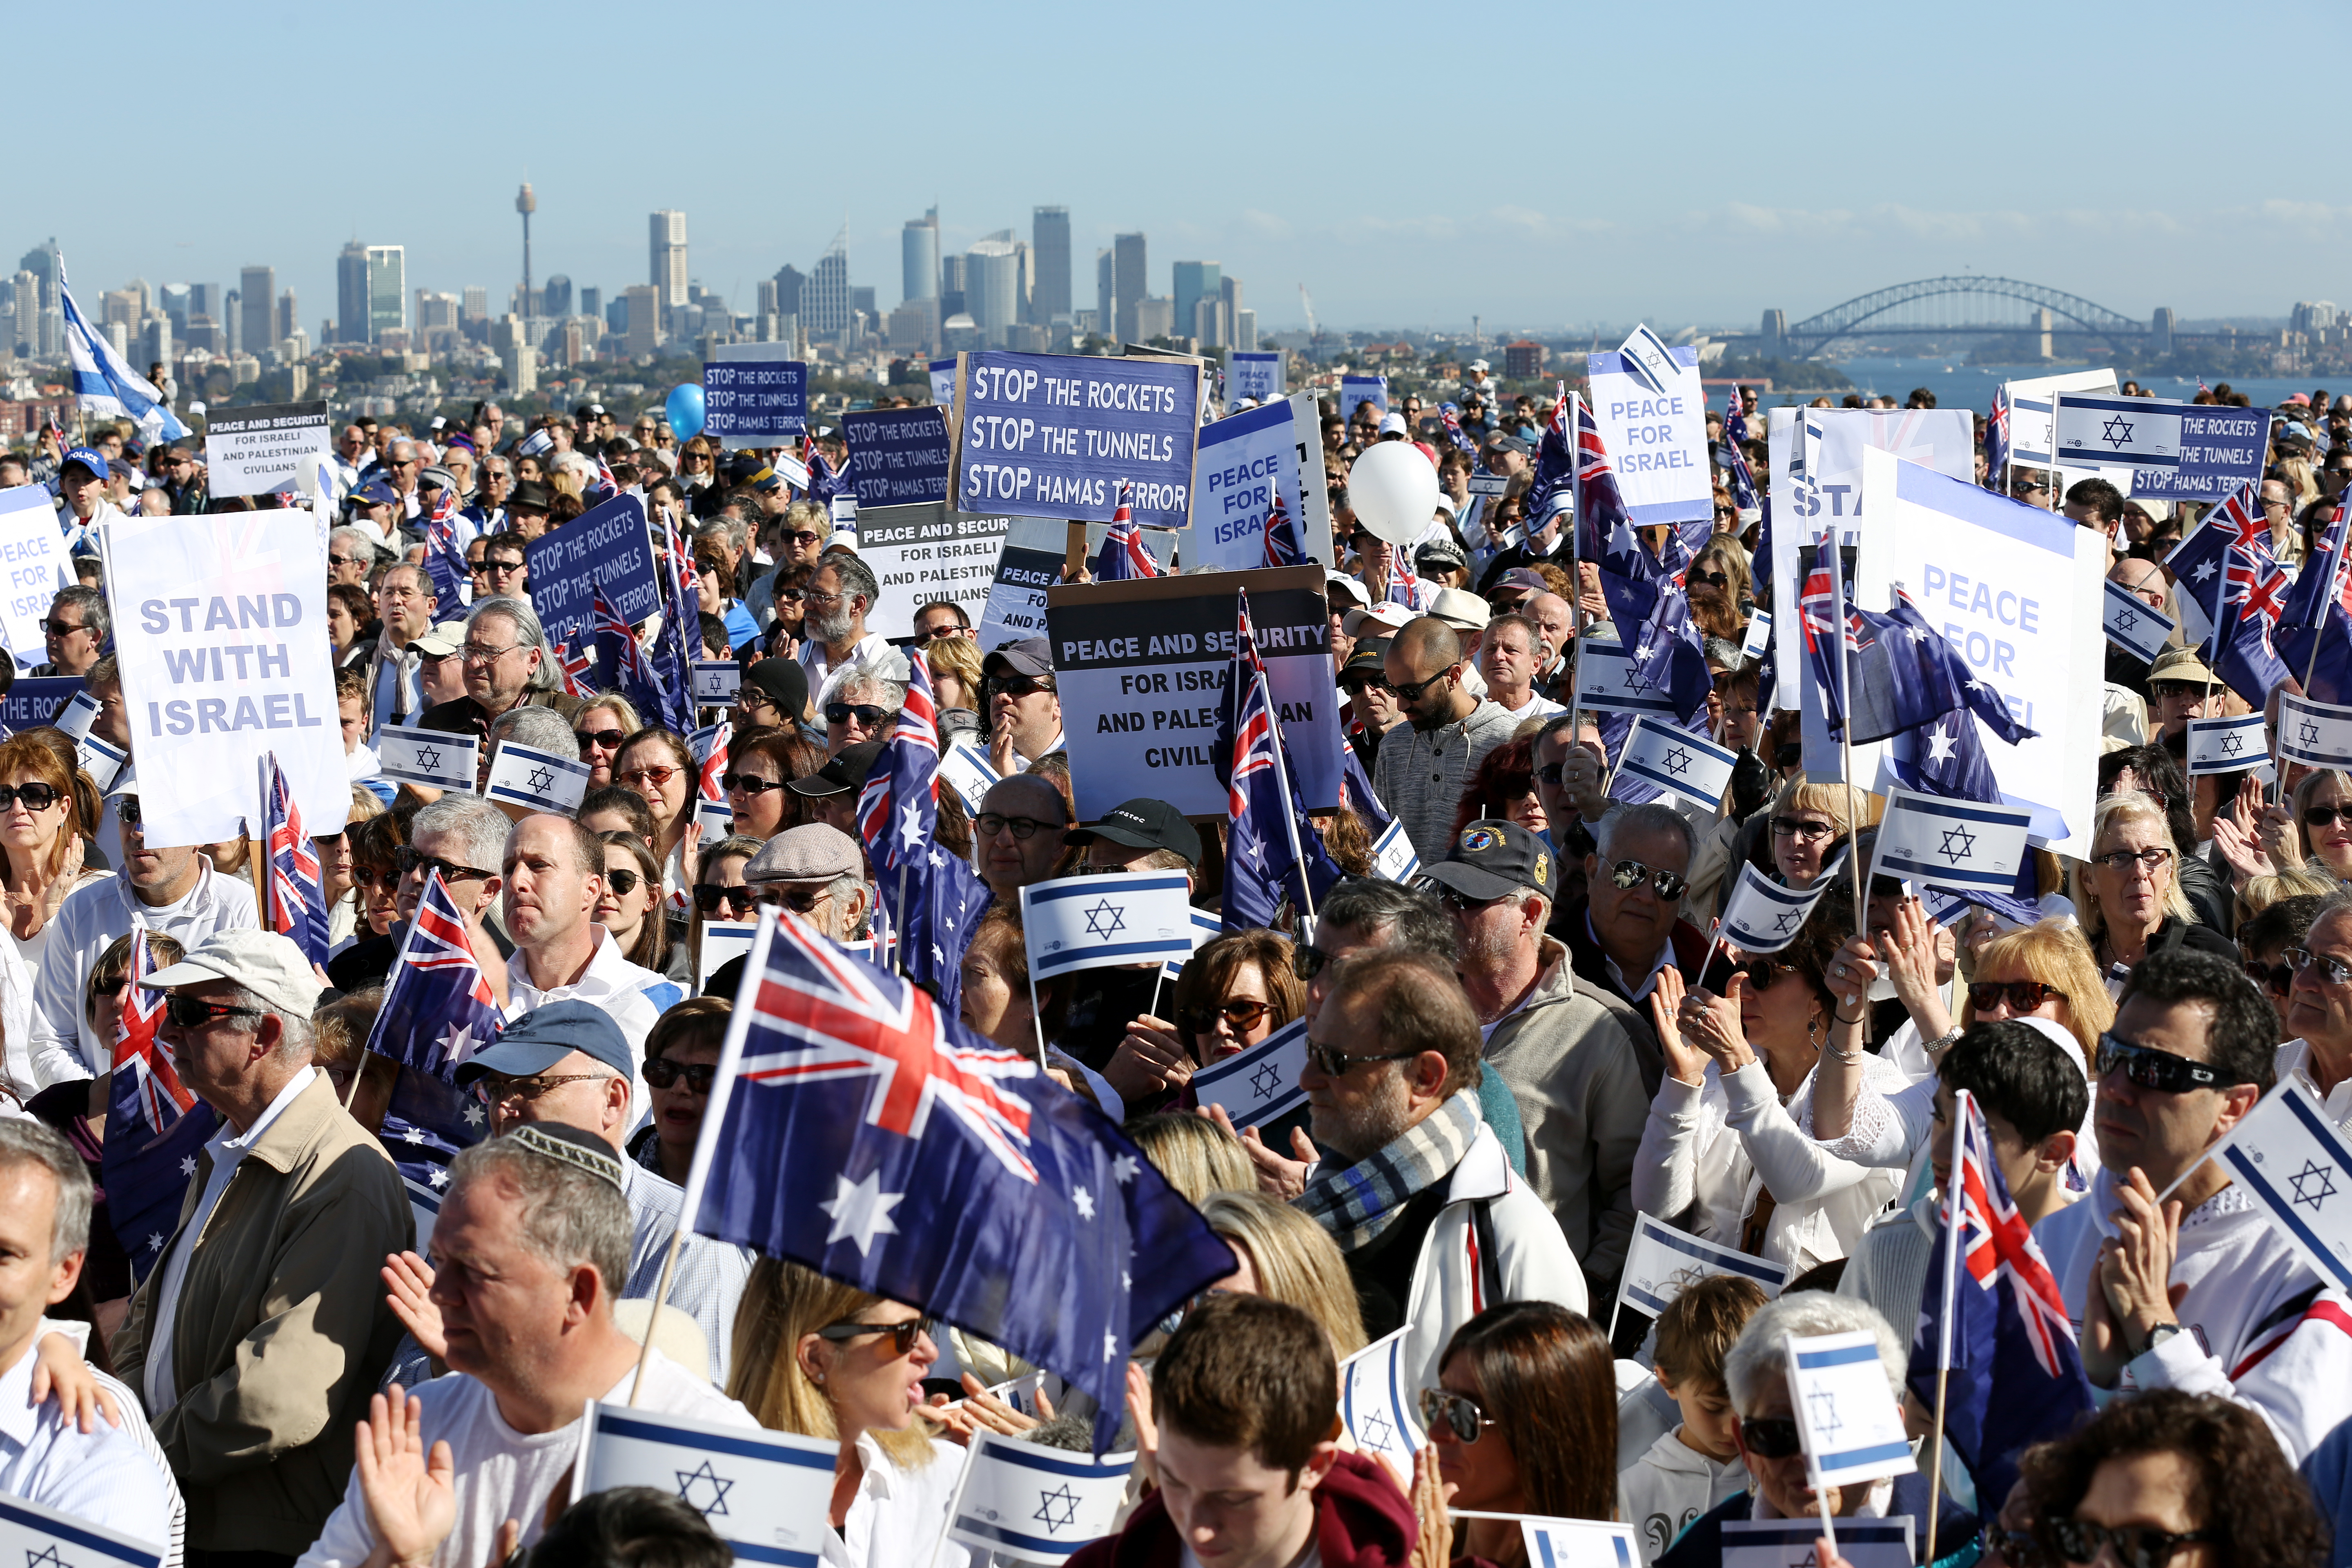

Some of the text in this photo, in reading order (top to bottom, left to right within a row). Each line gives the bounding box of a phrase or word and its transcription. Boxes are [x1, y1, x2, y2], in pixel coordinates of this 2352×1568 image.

[706, 368, 797, 385] STOP THE ROCKETS
[1245, 381, 1265, 389] FOR
[707, 391, 798, 407] STOP THE TUNNELS
[974, 367, 1175, 413] STOP THE ROCKETS
[1611, 397, 1683, 420] PEACE
[210, 414, 327, 433] PEACE AND SECURITY
[707, 413, 736, 429] STOP
[738, 416, 770, 429] HAMAS
[848, 420, 942, 443] STOP THE ROCKETS
[2184, 418, 2257, 437] THE ROCKETS
[235, 432, 301, 445] FOR ISRAELI
[971, 415, 1173, 462] STOP THE TUNNELS
[1627, 425, 1673, 445] FOR
[67, 451, 99, 465] POLICE
[223, 445, 318, 461] AND PALESTINIAN
[853, 448, 949, 471] STOP THE TUNNELS
[1618, 450, 1694, 473] ISRAEL
[2180, 446, 2254, 464] THE TUNNELS
[243, 463, 297, 474] CIVILIANS
[1209, 454, 1278, 492] PEACE
[859, 478, 889, 499] STOP
[891, 479, 924, 497] HAMAS
[967, 464, 1031, 500] STOP
[1037, 475, 1105, 506] HAMAS
[2136, 470, 2173, 490] STOP
[2174, 475, 2212, 491] HAMAS
[1224, 486, 1267, 515] FOR
[864, 517, 1011, 543] PEACE AND SECUR
[1214, 511, 1268, 545] ISRA
[0, 536, 50, 562] EACE
[531, 510, 634, 579] STOP THE ROCKETS
[901, 542, 996, 562] FOR ISRAELI
[10, 565, 49, 589] FOR
[536, 547, 641, 616] STOP THE TUNNELS
[882, 572, 915, 586] AND
[1002, 567, 1050, 585] PEACE
[10, 590, 58, 617] ISRA
[615, 580, 657, 616] TERROR
[913, 587, 990, 606] CIVILIANS
[1027, 594, 1047, 608] FO
[1924, 564, 2039, 635] PEACE
[140, 593, 302, 635] STAND
[1002, 613, 1033, 628] AND
[1062, 624, 1326, 662] PEACE AND SEURITY
[1944, 622, 2015, 678] FOR
[163, 644, 290, 684] WITH
[1120, 673, 1169, 695] FOR
[2, 697, 28, 719] THE
[148, 693, 322, 736] ISRAEL
[1097, 712, 1145, 733] AND
